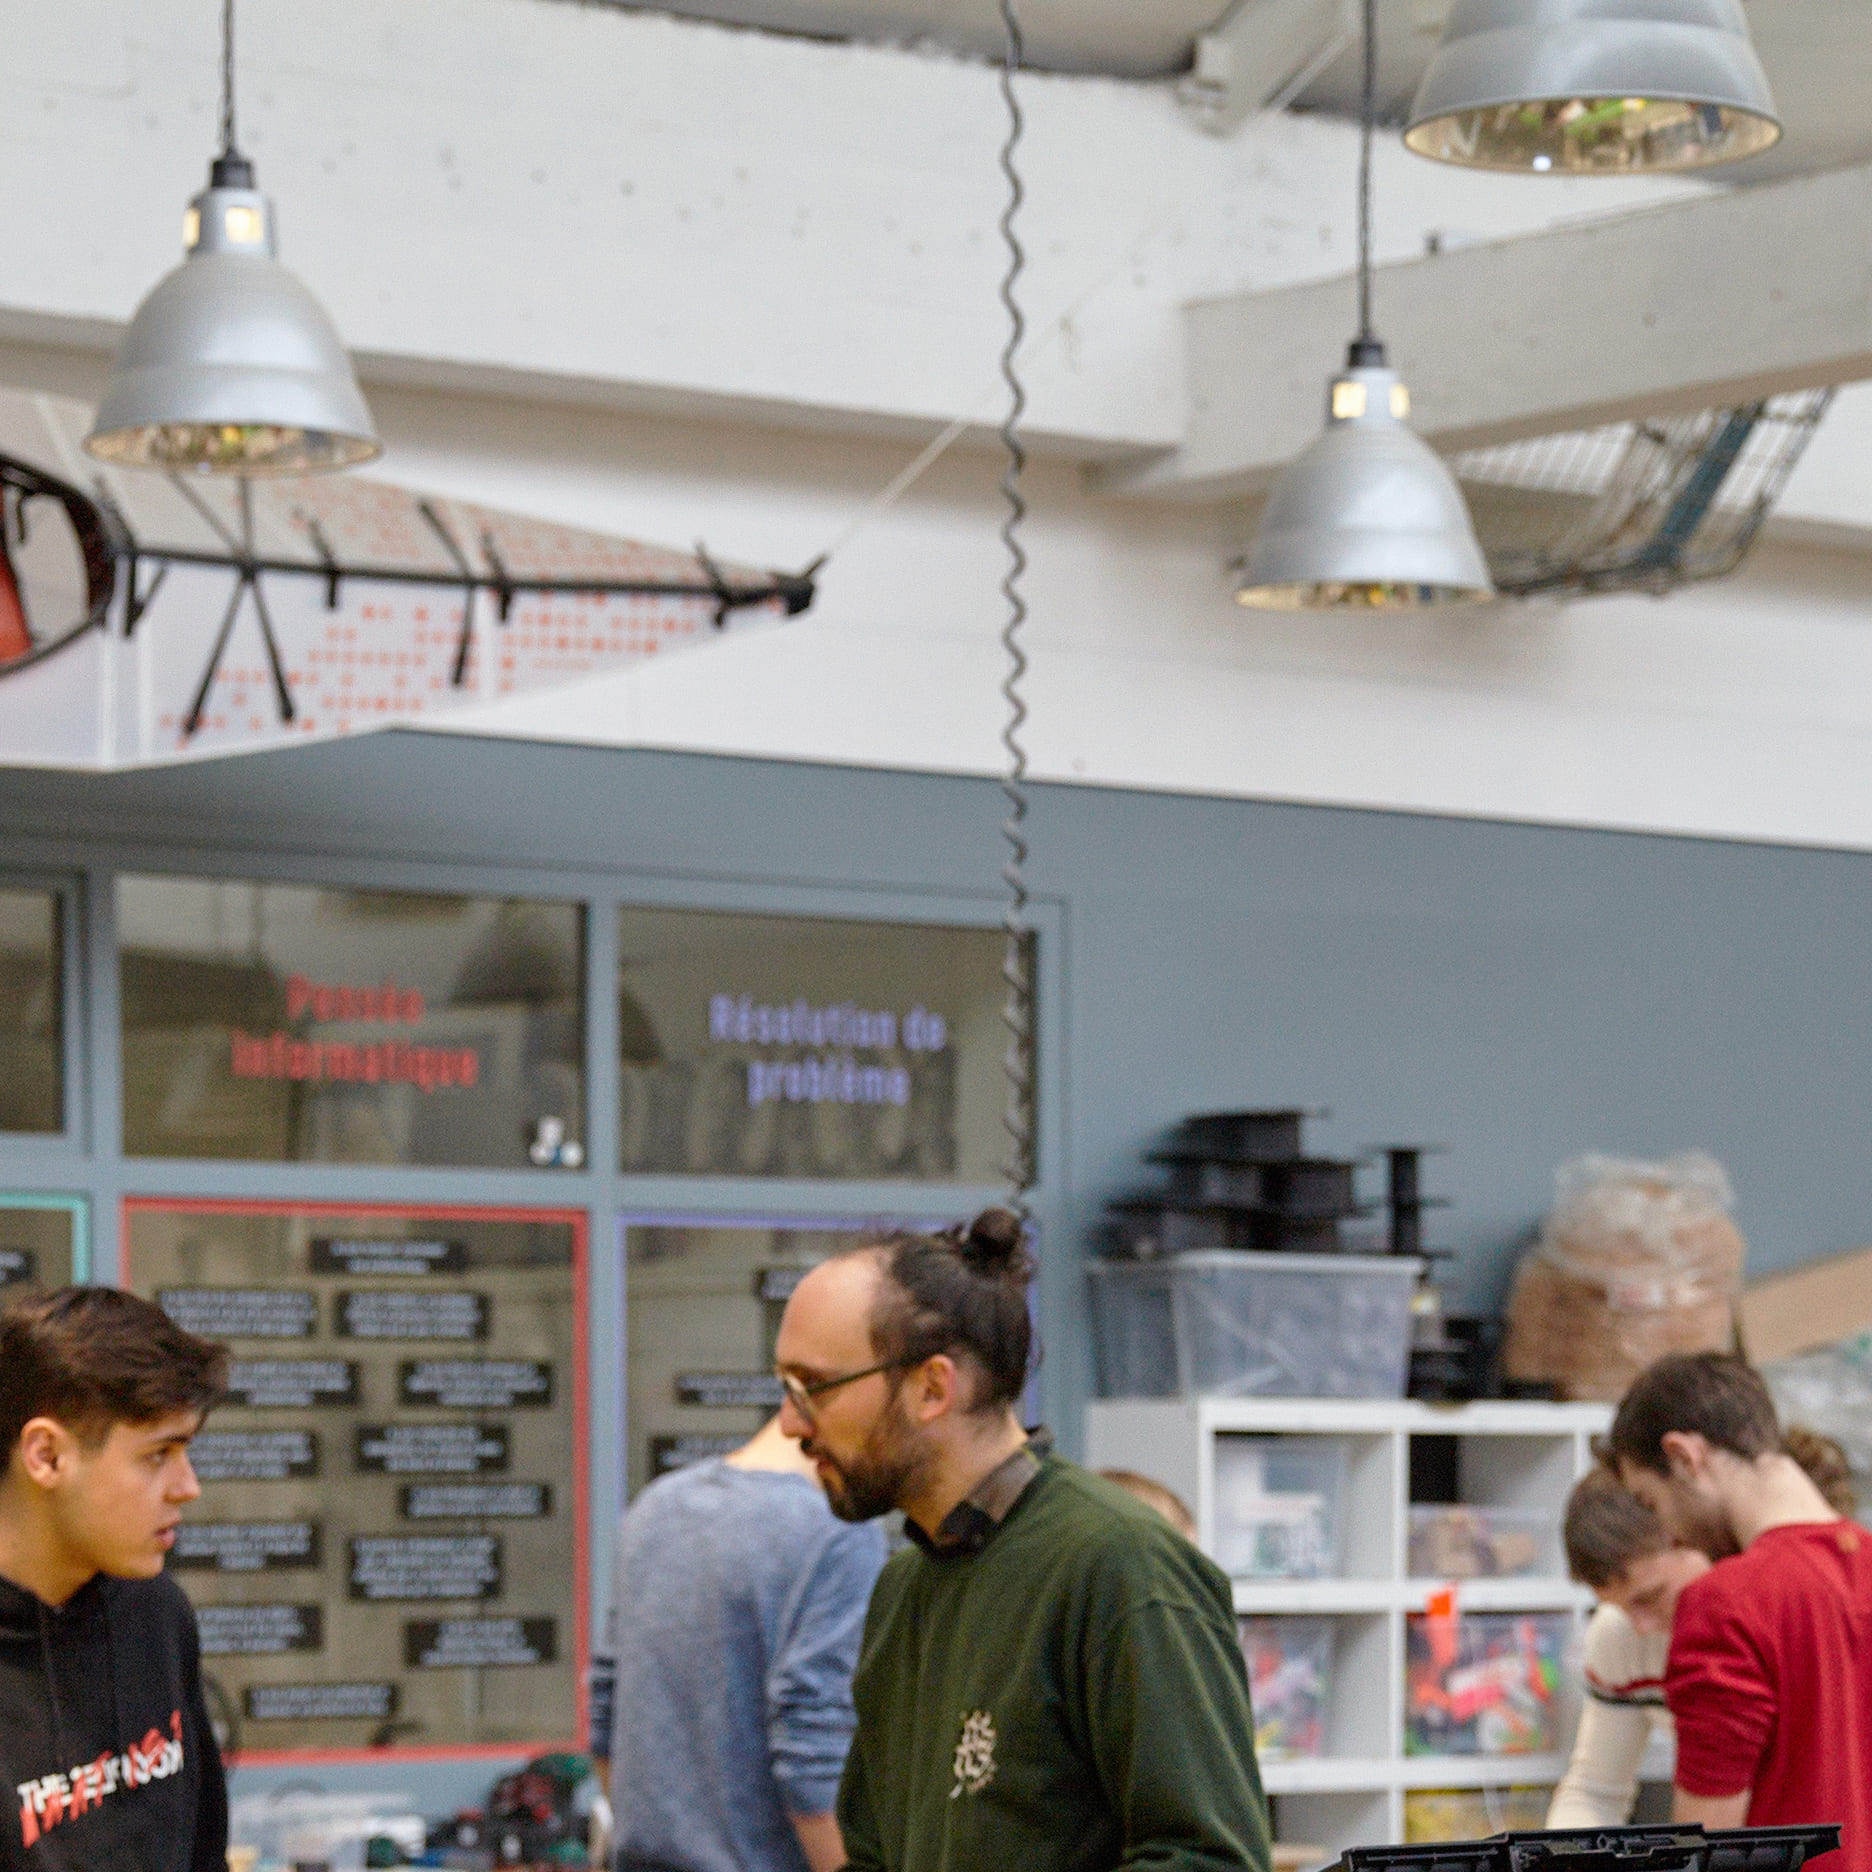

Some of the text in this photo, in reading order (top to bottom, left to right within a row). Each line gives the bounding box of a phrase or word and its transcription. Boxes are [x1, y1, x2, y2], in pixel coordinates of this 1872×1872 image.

[286, 972, 426, 1026] Pensée
[709, 993, 946, 1052] Résolution de
[747, 1055, 911, 1109] problème
